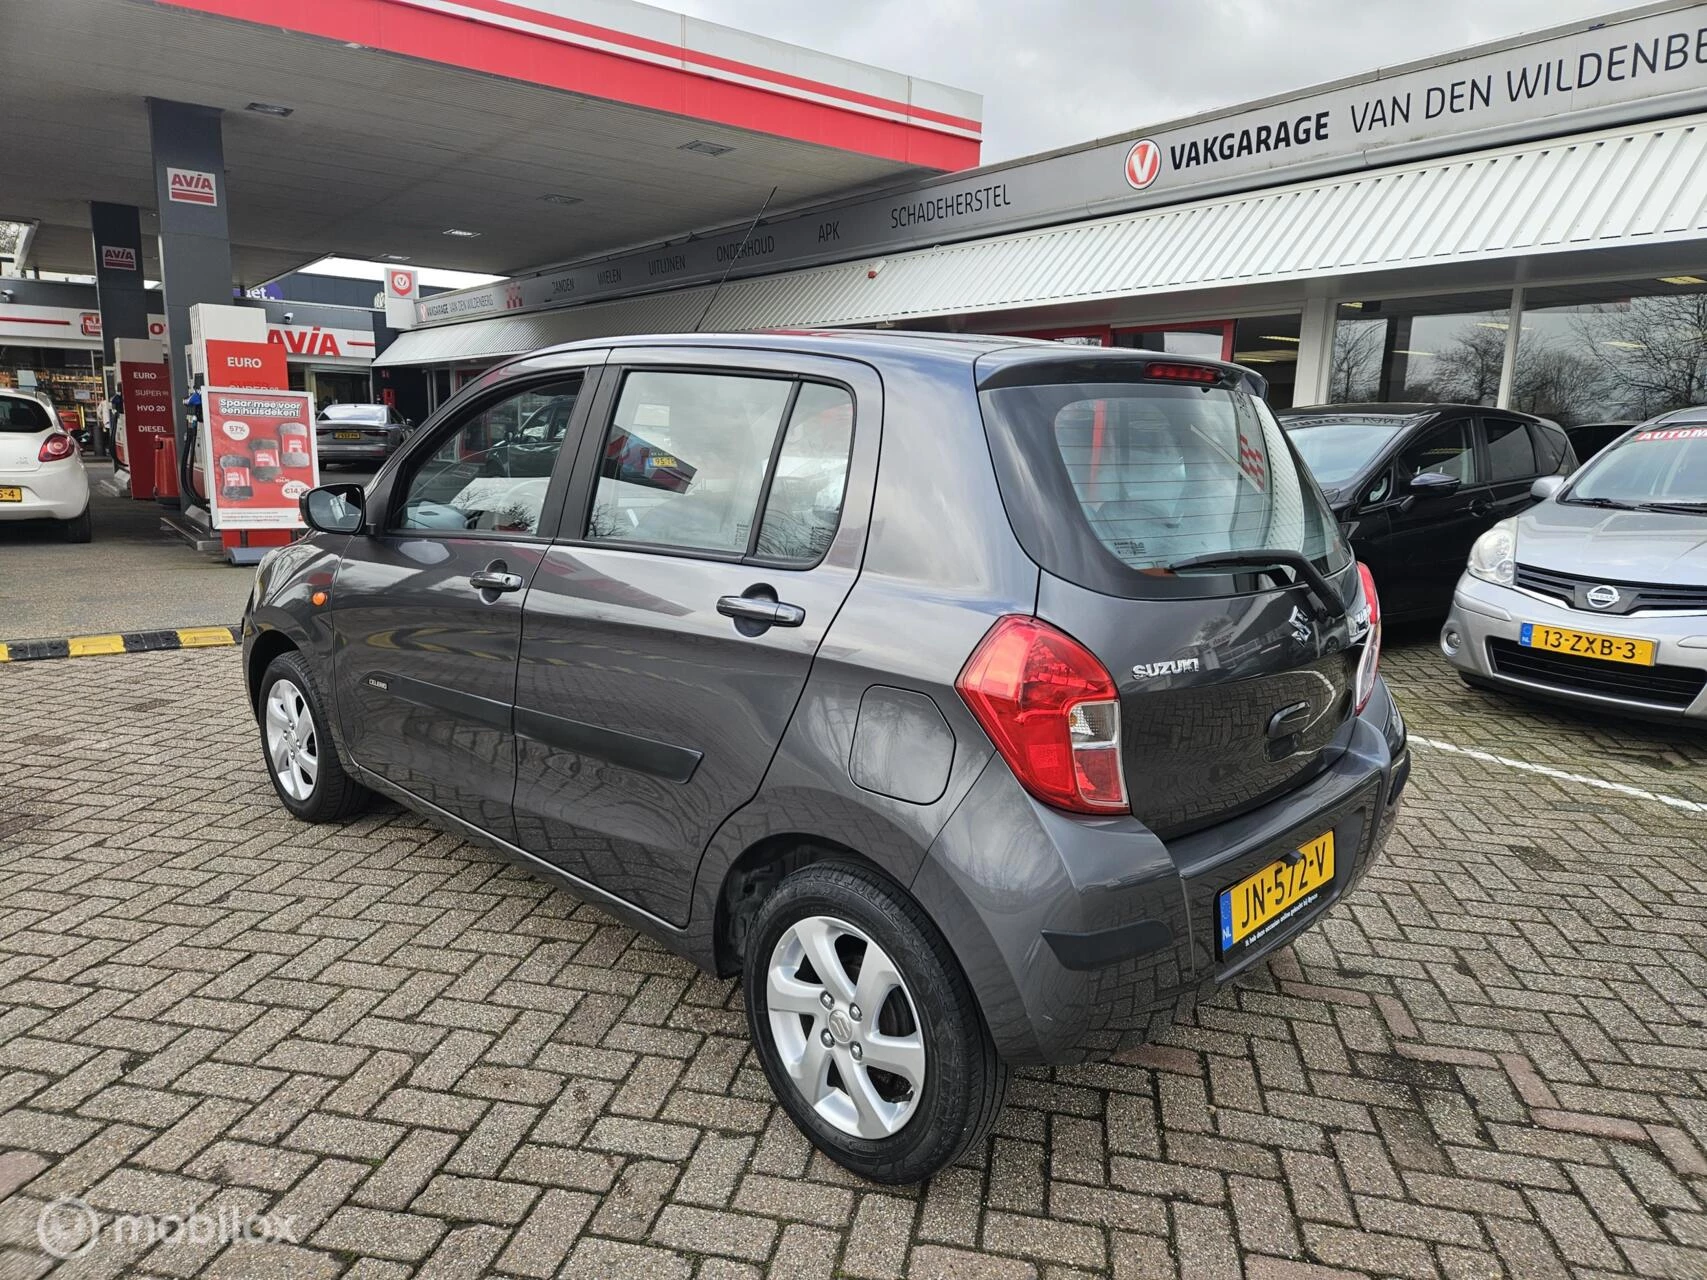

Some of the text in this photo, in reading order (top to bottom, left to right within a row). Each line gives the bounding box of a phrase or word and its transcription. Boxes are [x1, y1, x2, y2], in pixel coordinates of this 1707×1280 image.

[1170, 111, 1330, 171] VAKGARAGE
[1350, 95, 1410, 133] VAN
[1425, 75, 1492, 119] DEN
[1507, 27, 1707, 102] WILDENBE
[891, 184, 1011, 229] SCHADEHERSTEL
[818, 221, 840, 243] APK
[716, 235, 775, 262] ONDERHOUD
[227, 357, 262, 368] EURO
[133, 371, 157, 379] EURO
[136, 404, 155, 412] HVO
[220, 398, 250, 408] Spaar
[242, 408, 299, 417] huisdeken!
[138, 425, 167, 433] DIESEL
[1544, 630, 1636, 659] 13-ZXB-3
[1133, 658, 1199, 679] SUZUKI
[1222, 841, 1326, 940] NL JN-572-V
